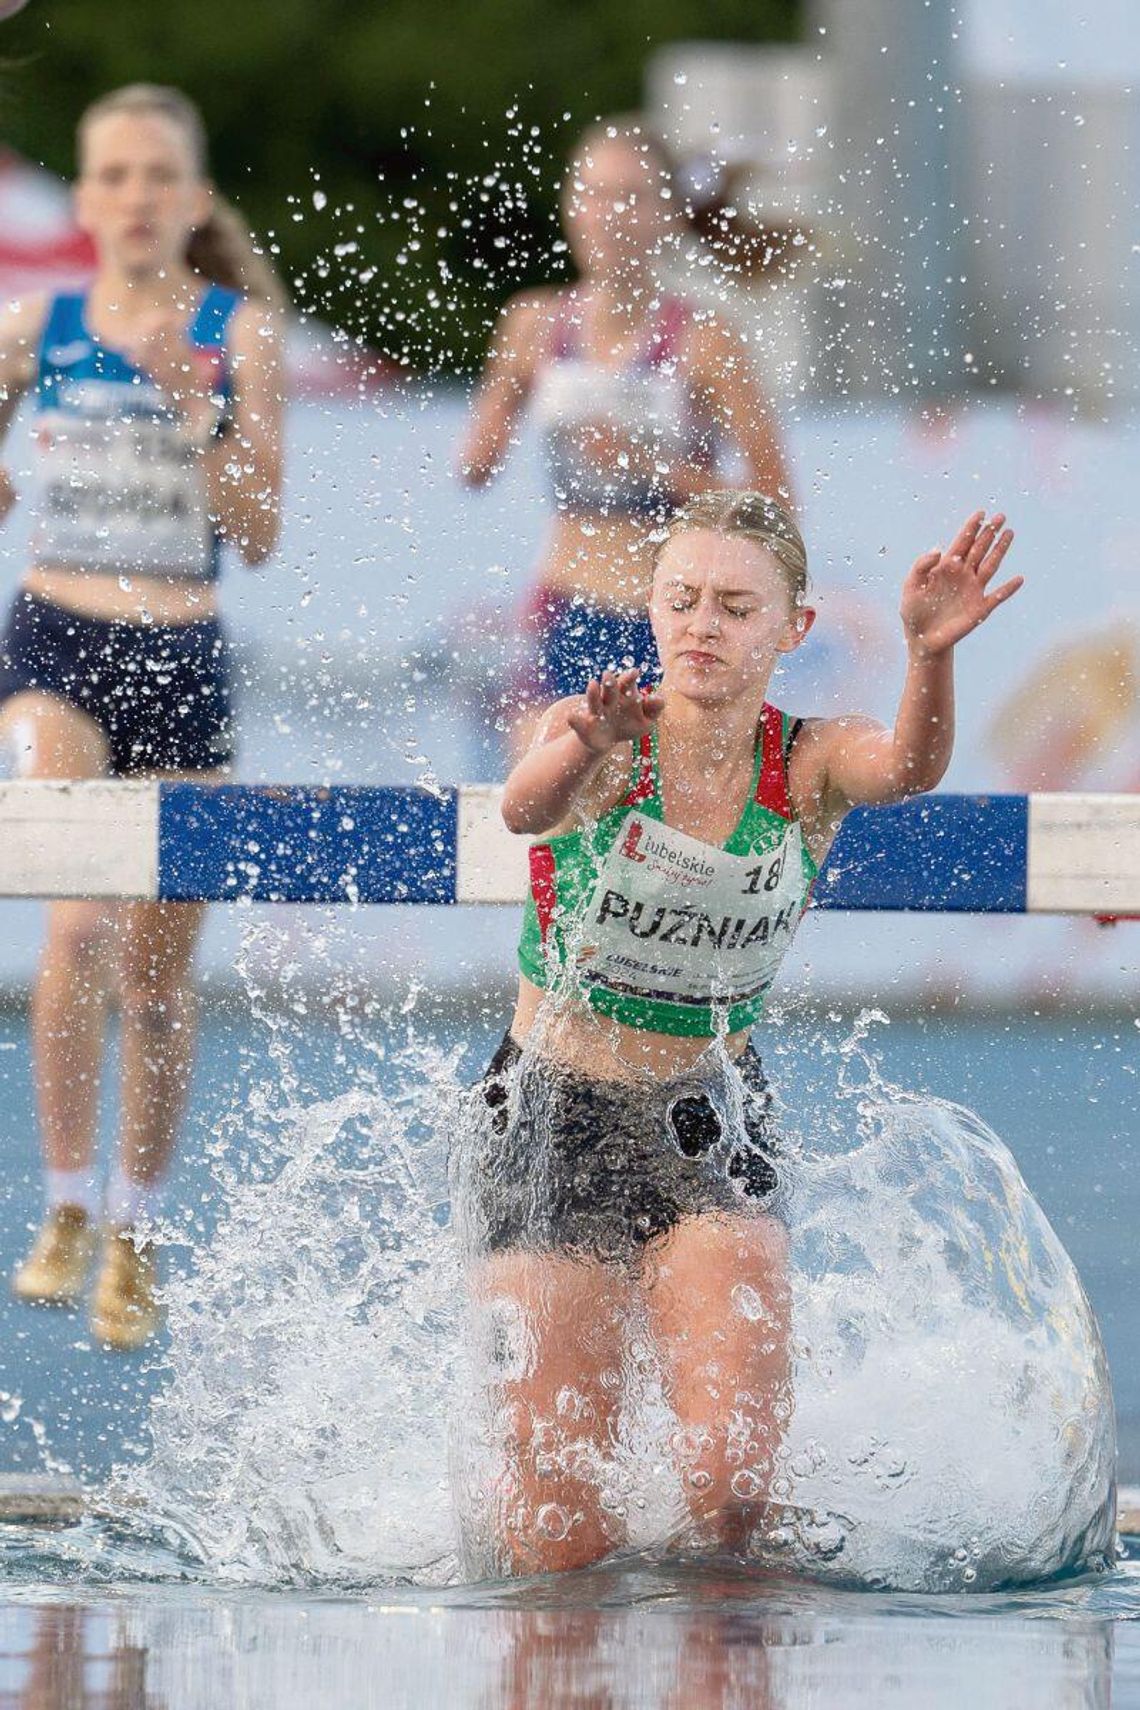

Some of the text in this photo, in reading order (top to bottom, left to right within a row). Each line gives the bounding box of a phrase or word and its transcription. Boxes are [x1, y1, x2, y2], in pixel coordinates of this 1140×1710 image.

[619, 819, 715, 876] Lubelskie
[596, 889, 796, 950] PUŹNIAK
[606, 953, 684, 978] LUBELSKIE
